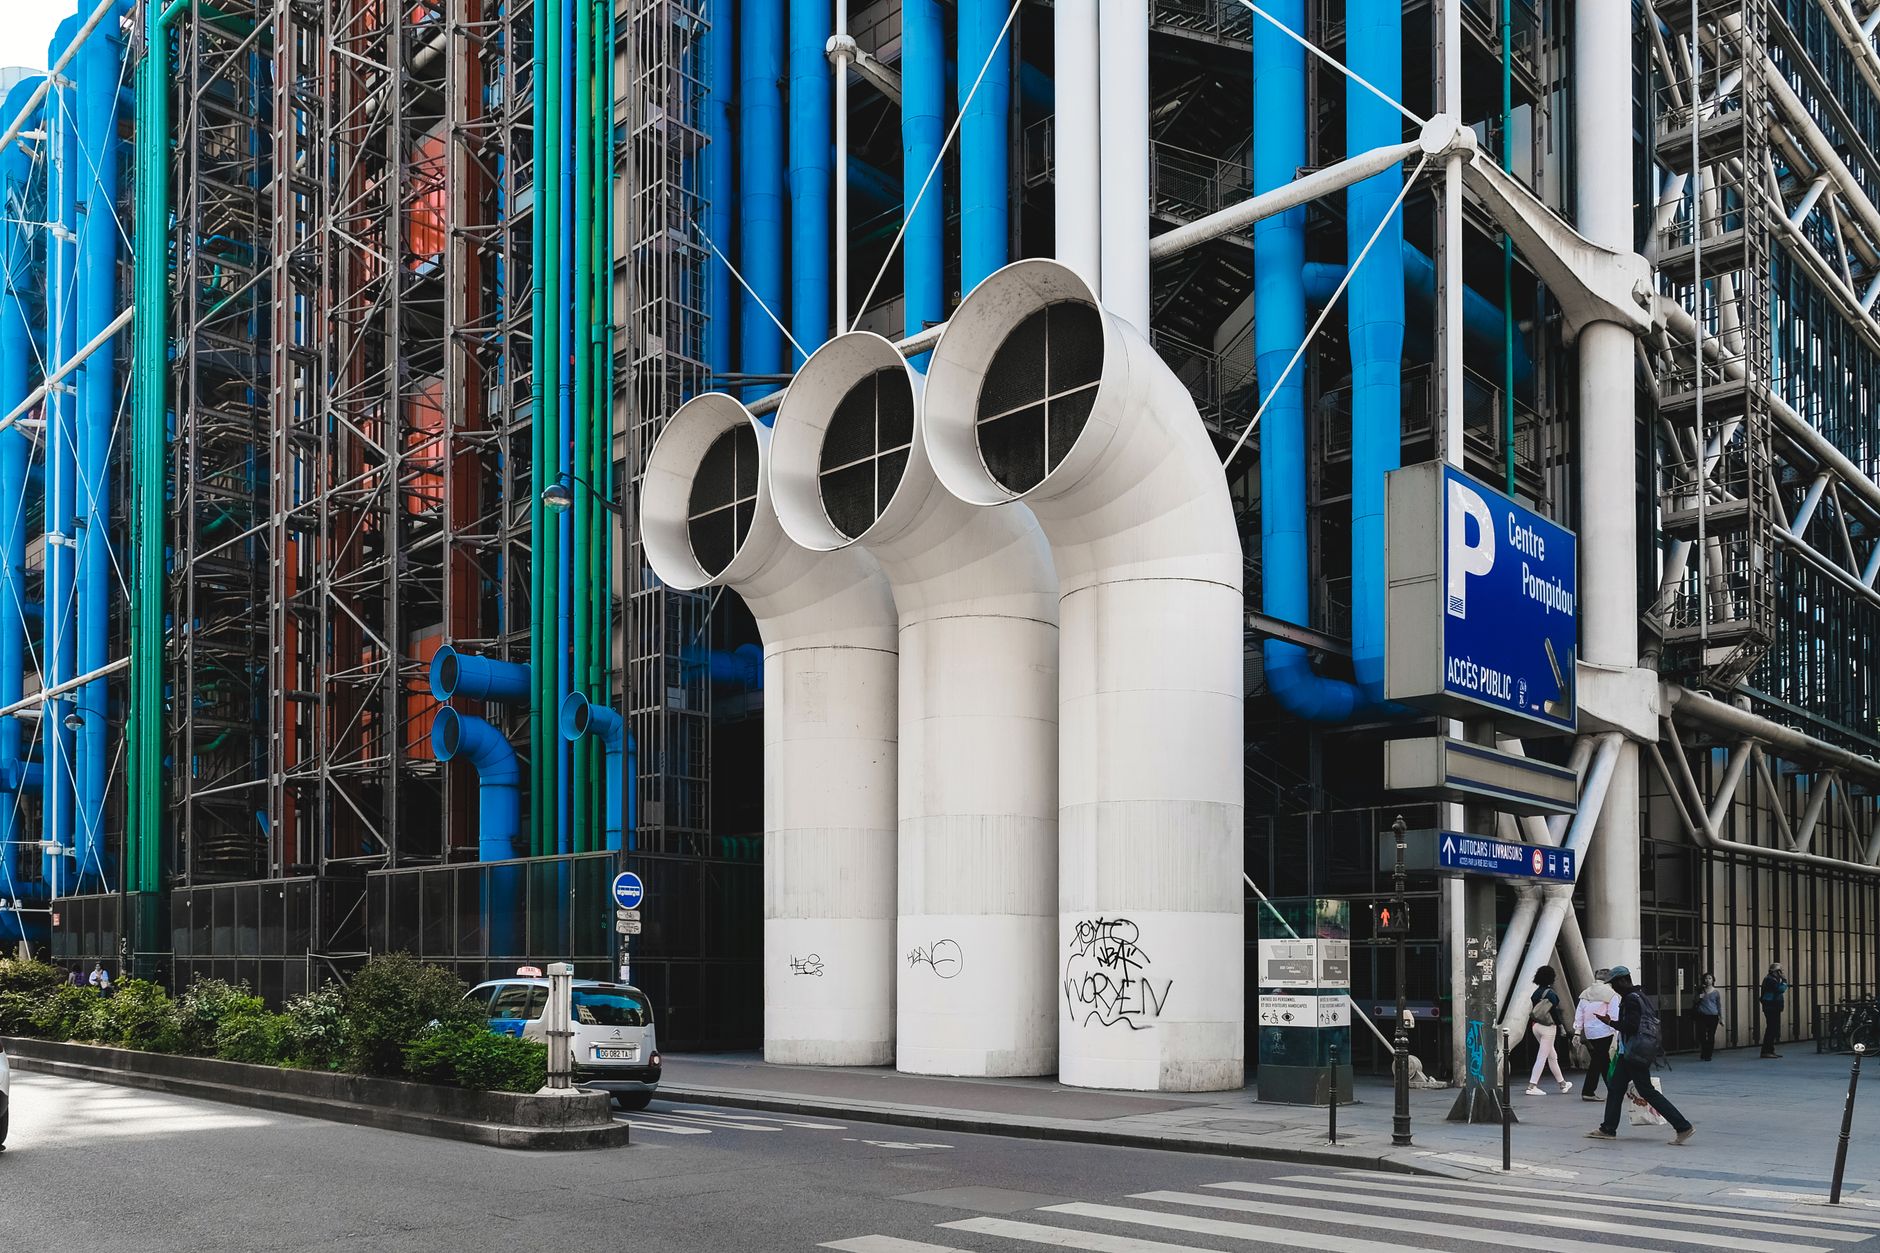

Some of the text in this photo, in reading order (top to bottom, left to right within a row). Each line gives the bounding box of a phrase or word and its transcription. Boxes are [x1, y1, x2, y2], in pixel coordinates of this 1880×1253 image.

[1448, 478, 1495, 619] P
[1508, 511, 1545, 561] Centre
[1522, 562, 1573, 616] Pompidou
[1448, 655, 1512, 701] ACCÈS PUBLIC
[1459, 840, 1488, 857] AUTOCARS
[1492, 843, 1523, 862] LIVRAISONS
